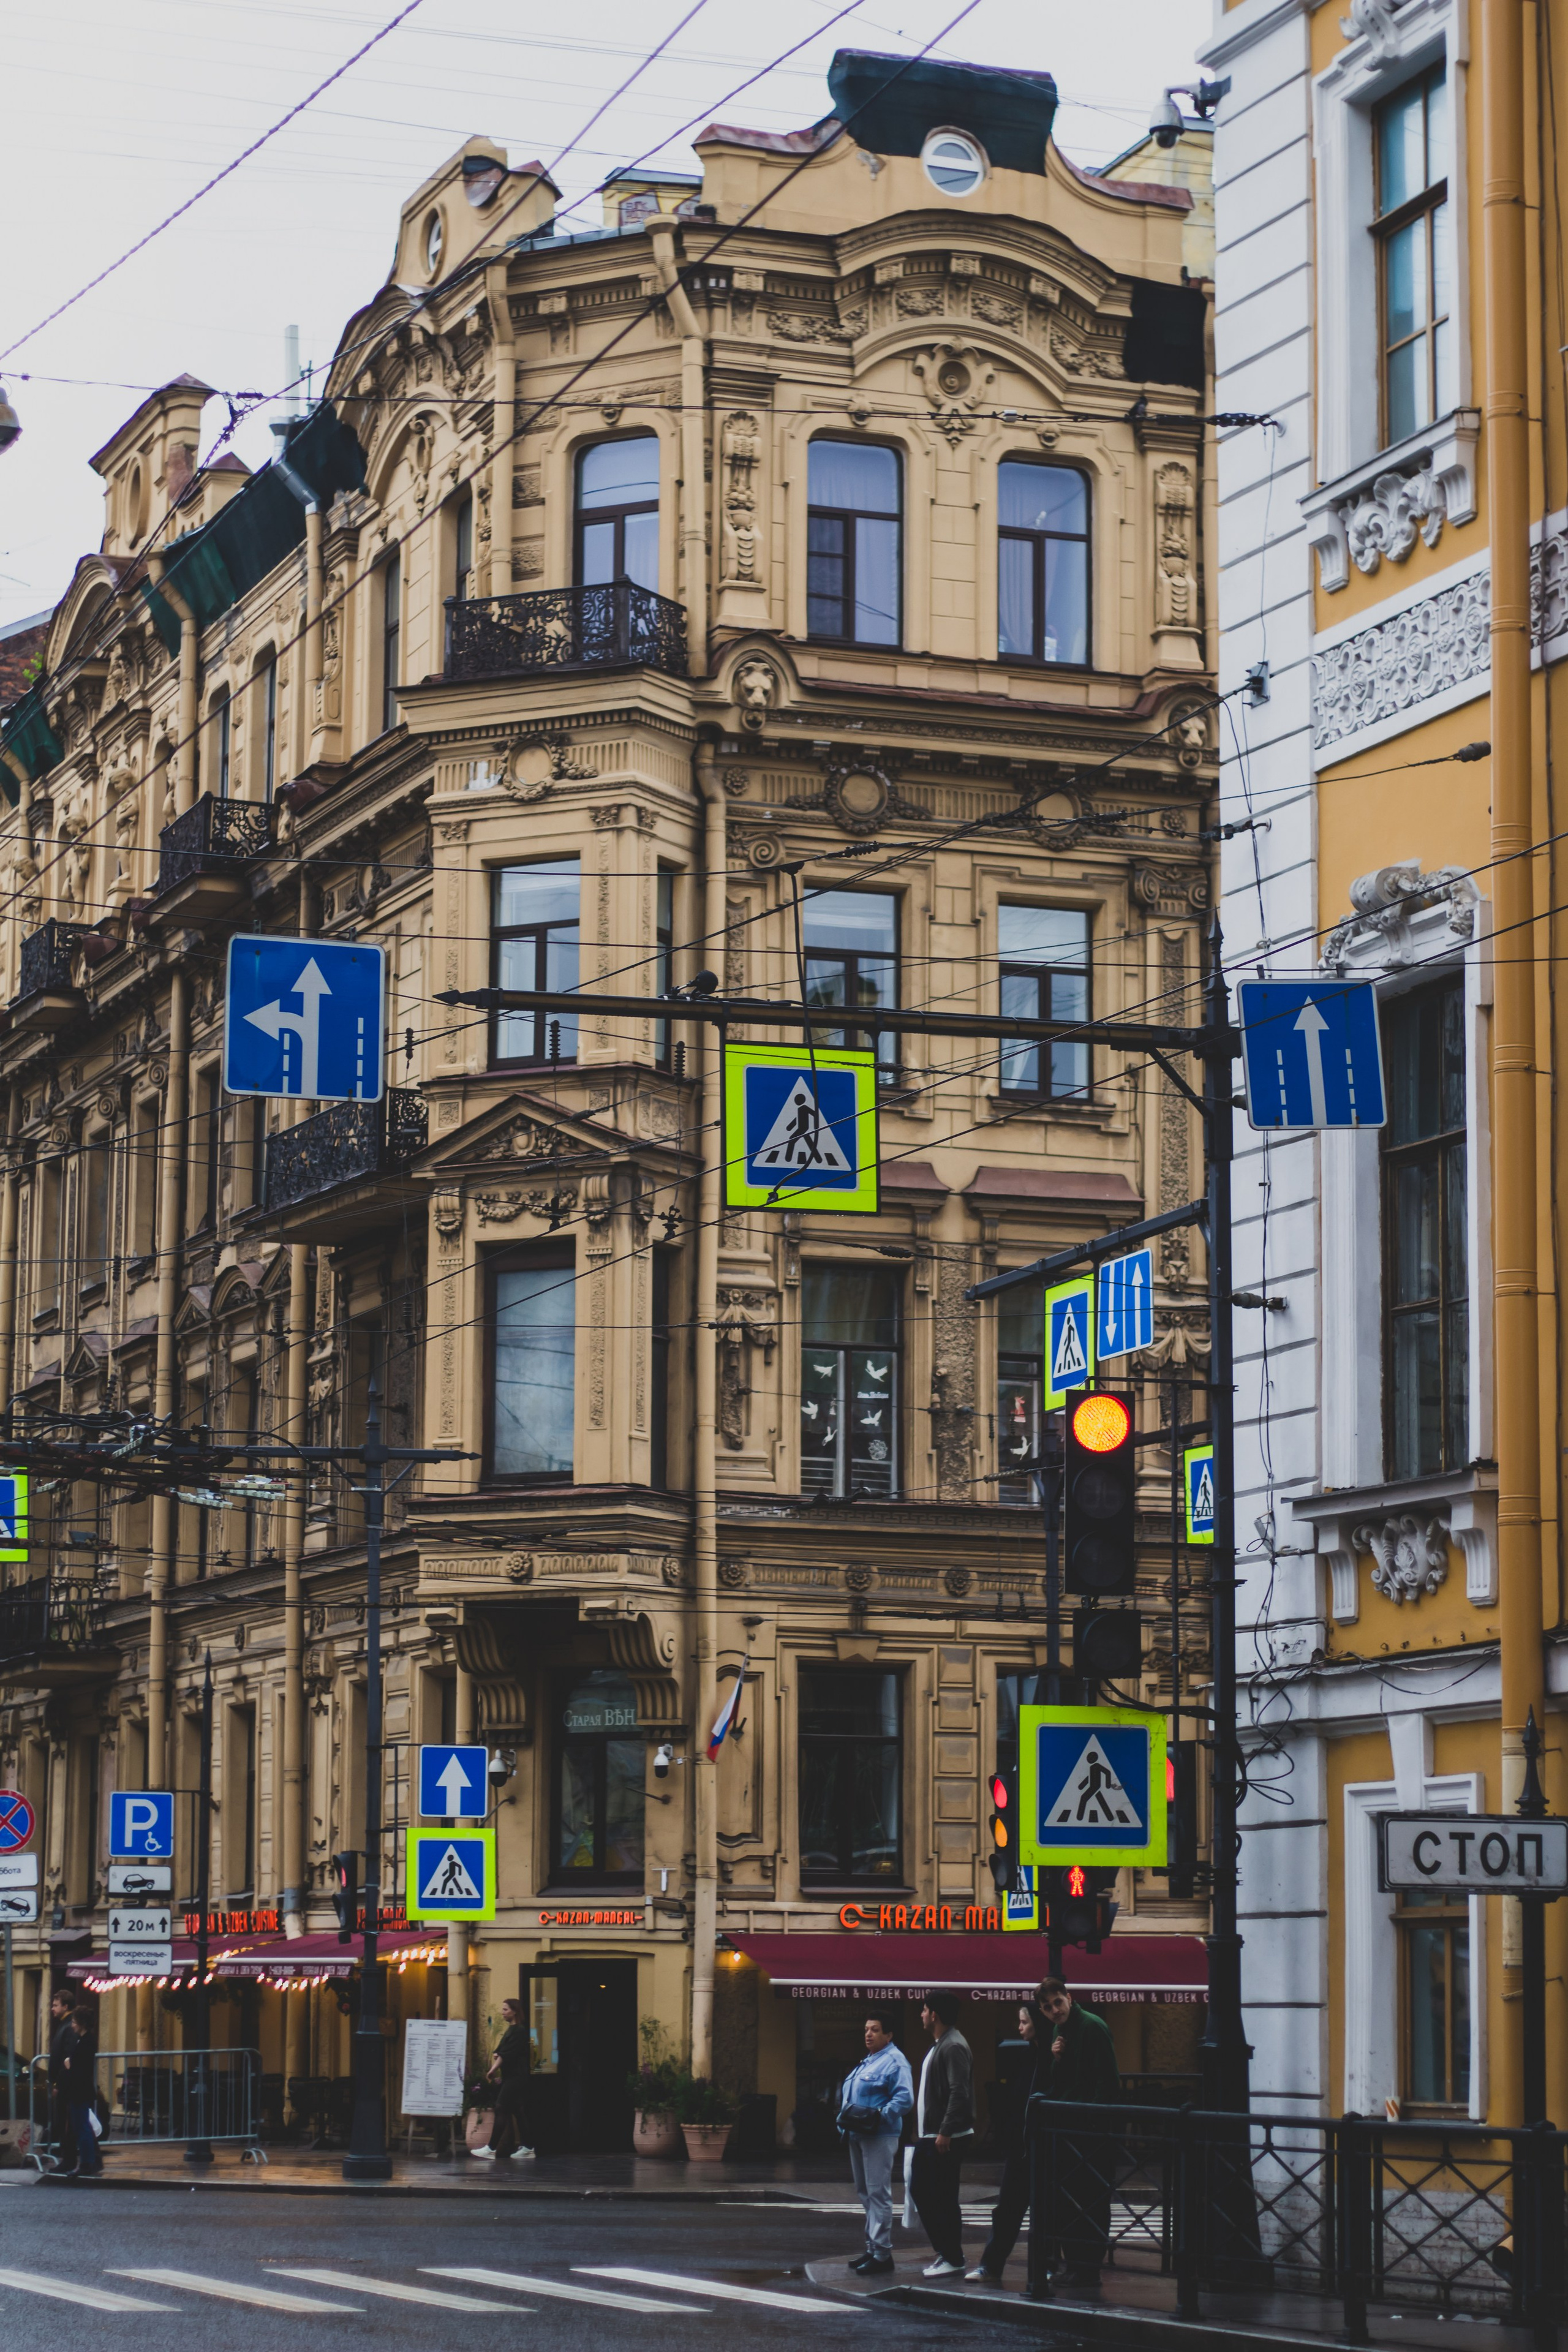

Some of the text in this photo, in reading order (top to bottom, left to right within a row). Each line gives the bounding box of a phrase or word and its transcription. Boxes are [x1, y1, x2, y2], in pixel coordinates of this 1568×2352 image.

[124, 1798, 159, 1847] P
[1412, 1831, 1543, 1877] СТОП
[226, 1912, 248, 1932] UZBEK
[251, 1909, 279, 1931] CUISINE
[792, 1987, 846, 1998] GEORGIAN
[853, 1988, 859, 1998] &
[867, 1988, 900, 1999] UZBEK
[1091, 1991, 1145, 2002] GEORGIAN
[1151, 1992, 1157, 2002] &
[1164, 1992, 1197, 2003] UZBEK
